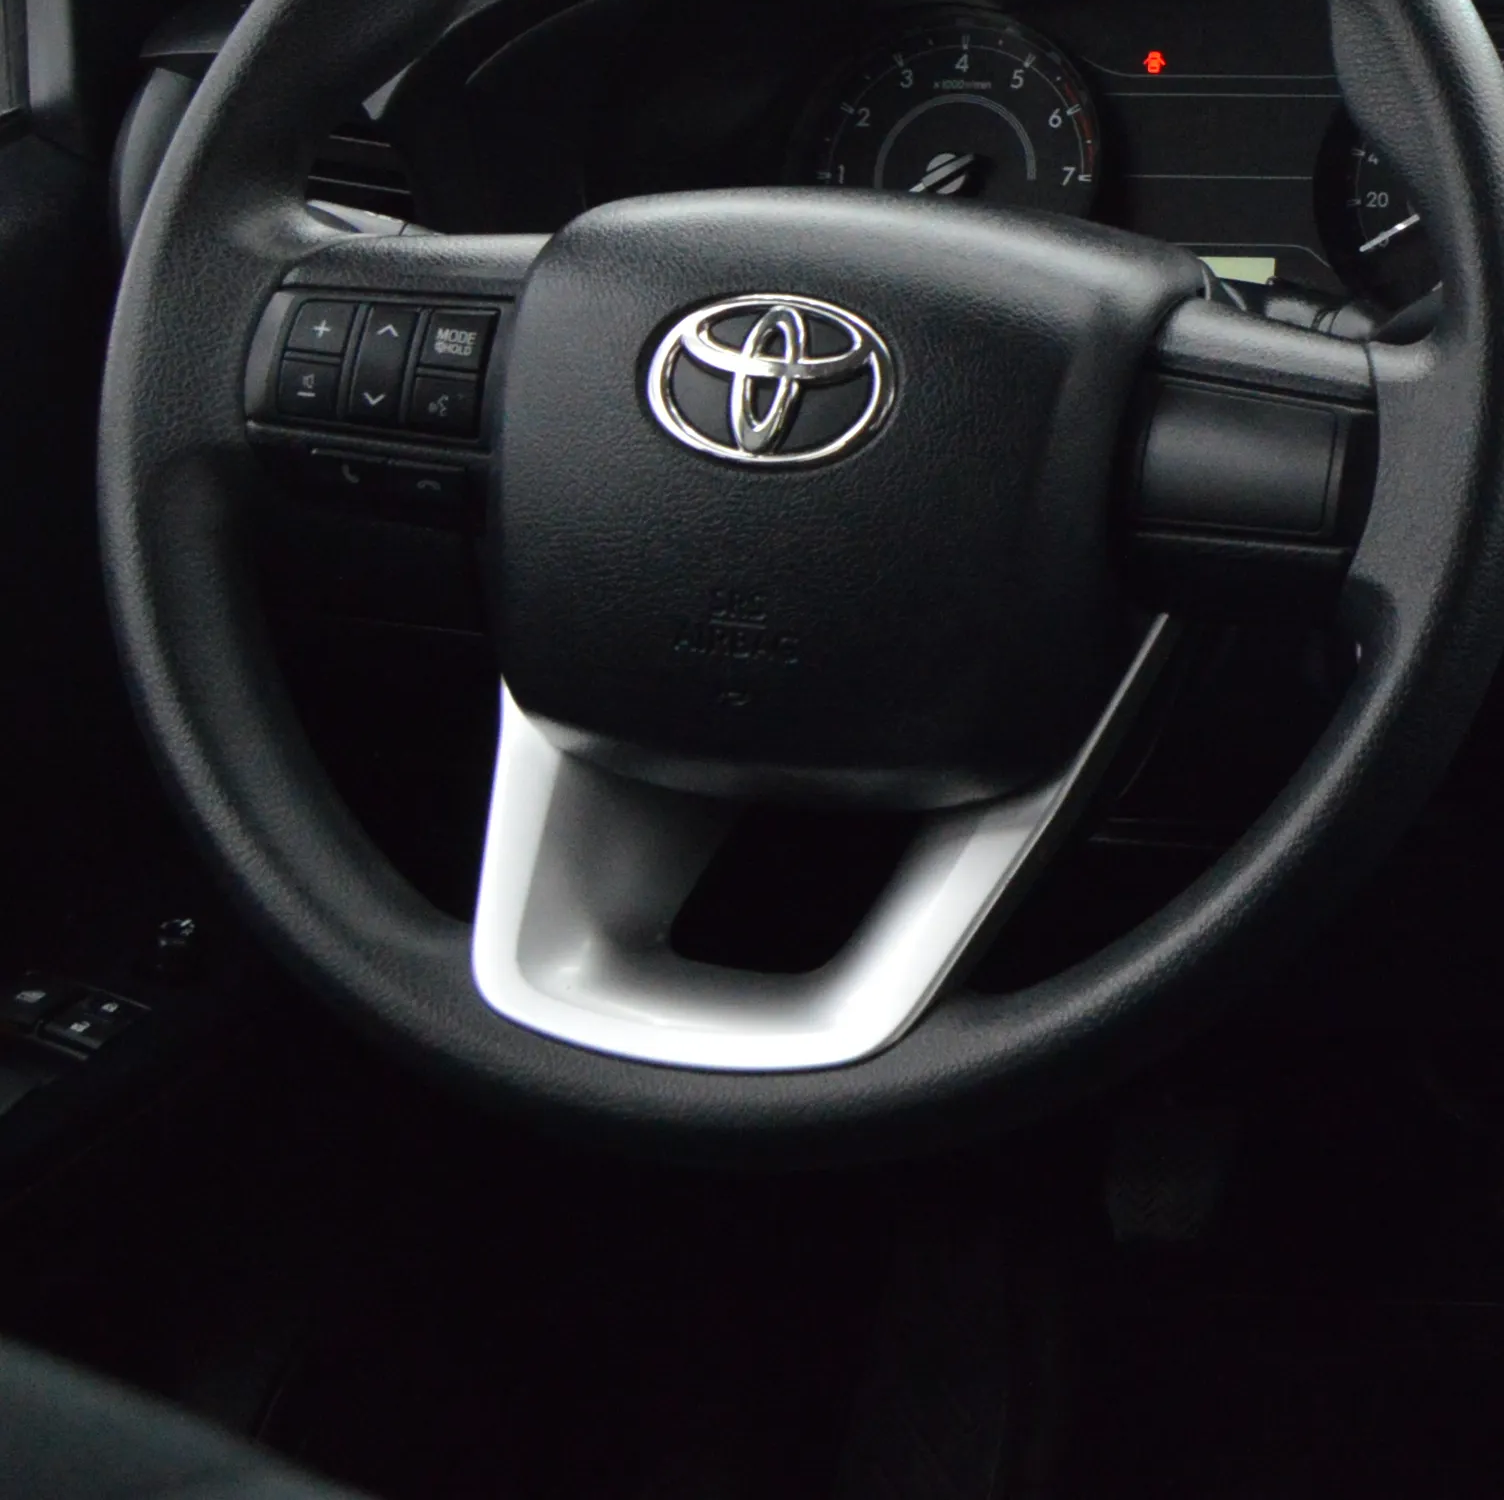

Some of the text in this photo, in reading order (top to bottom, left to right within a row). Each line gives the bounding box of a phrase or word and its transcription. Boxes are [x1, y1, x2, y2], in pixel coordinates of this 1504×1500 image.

[954, 52, 970, 73] 4
[900, 68, 914, 89] 3
[1009, 69, 1025, 90] 5
[856, 107, 871, 127] 2
[1048, 109, 1062, 128] 6
[837, 164, 845, 184] 1
[1062, 164, 1077, 187] 7
[1365, 191, 1389, 208] 20
[436, 327, 477, 344] MODE
